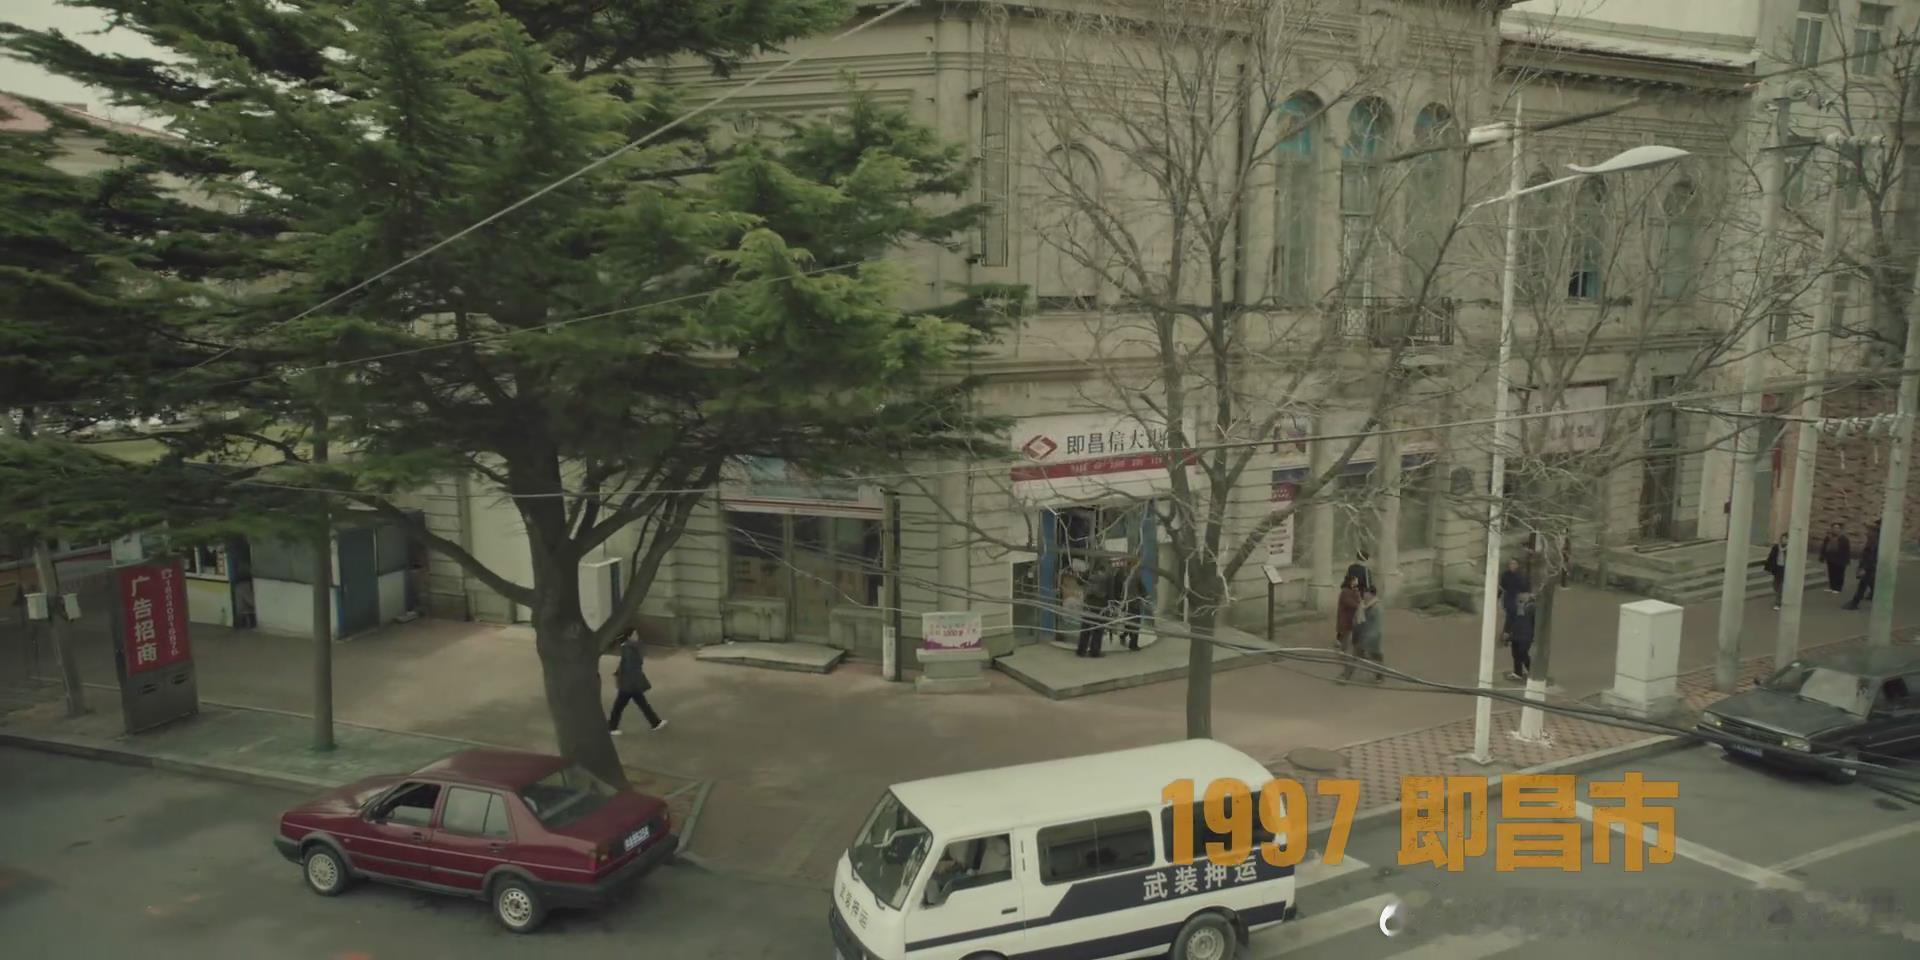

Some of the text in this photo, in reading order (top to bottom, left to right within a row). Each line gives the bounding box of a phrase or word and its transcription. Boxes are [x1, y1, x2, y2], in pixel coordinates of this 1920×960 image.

[131, 576, 157, 665] 广告招商
[1143, 855, 1257, 901] 武装押运
